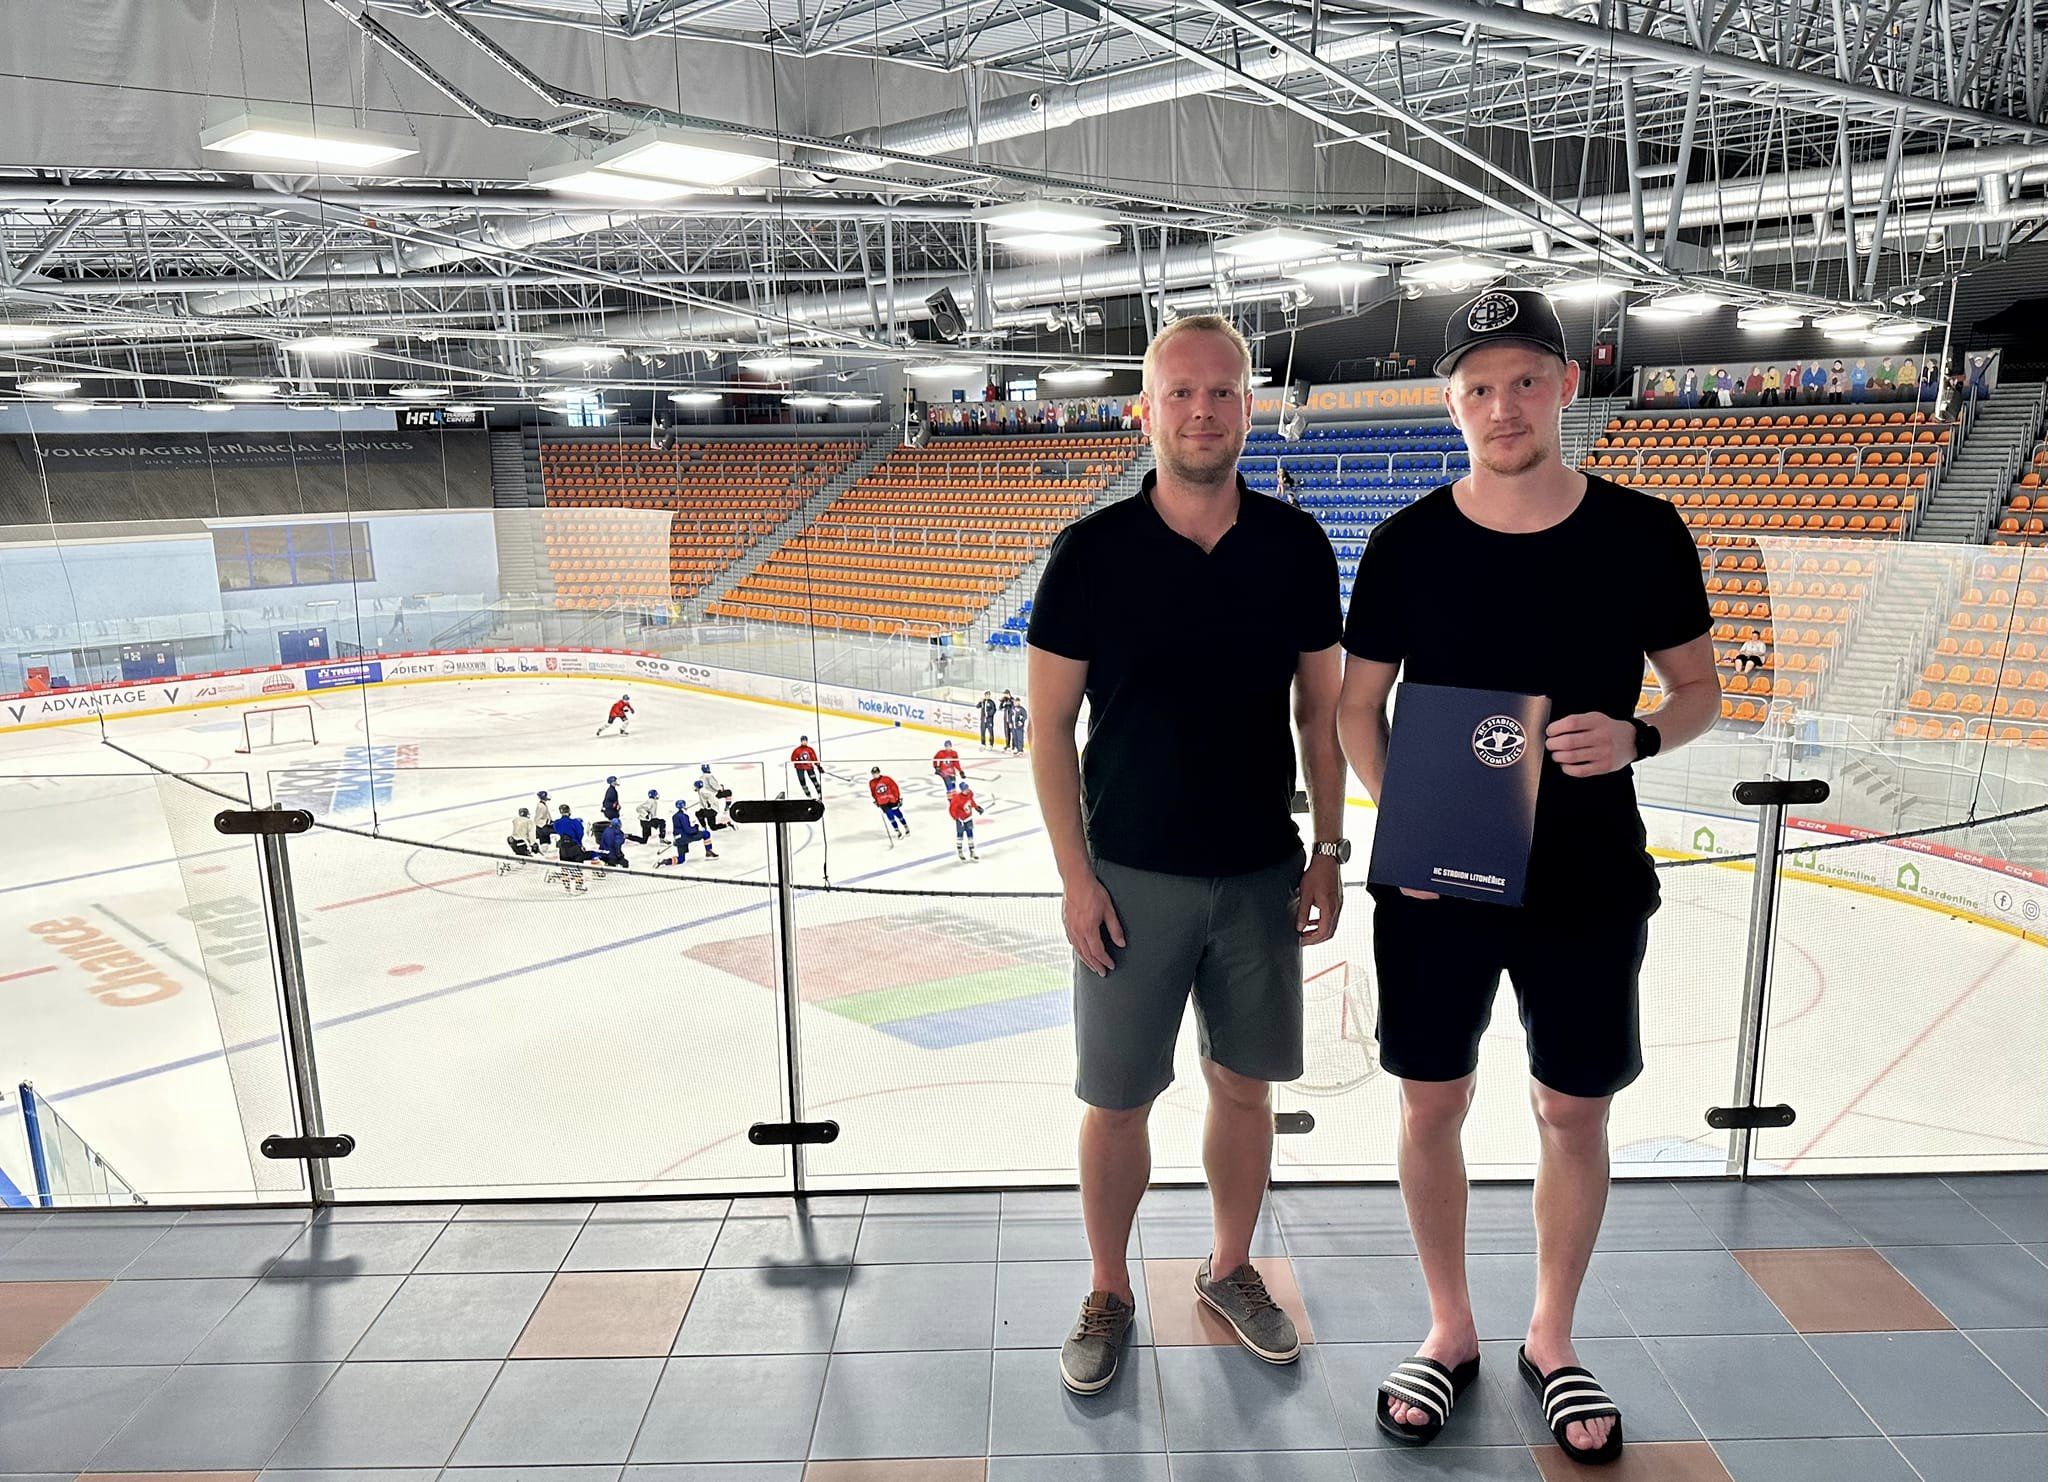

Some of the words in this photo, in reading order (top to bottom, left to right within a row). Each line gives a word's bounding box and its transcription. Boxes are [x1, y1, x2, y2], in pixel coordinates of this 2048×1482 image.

[1486, 302, 1497, 321] B
[405, 412, 438, 425] HFL
[37, 446, 202, 457] VOLKSWAGEN
[210, 443, 321, 455] FINANCIAL
[325, 441, 414, 451] SERVICES
[389, 664, 435, 675] ADIENT
[42, 690, 146, 713] ADVANTAGE
[858, 698, 926, 720] hokejkaTV.cz
[1486, 718, 1520, 732] STADION
[1797, 820, 1827, 831] CCM
[1903, 840, 1932, 851] CCM
[1954, 851, 1983, 864] CCM
[1433, 867, 1442, 875] HC
[1443, 868, 1470, 880] STADION
[1817, 863, 1877, 883] Gardenline
[2005, 865, 2033, 878] CCM
[1920, 886, 1979, 909] Gardenline
[28, 916, 183, 1007] Chance
